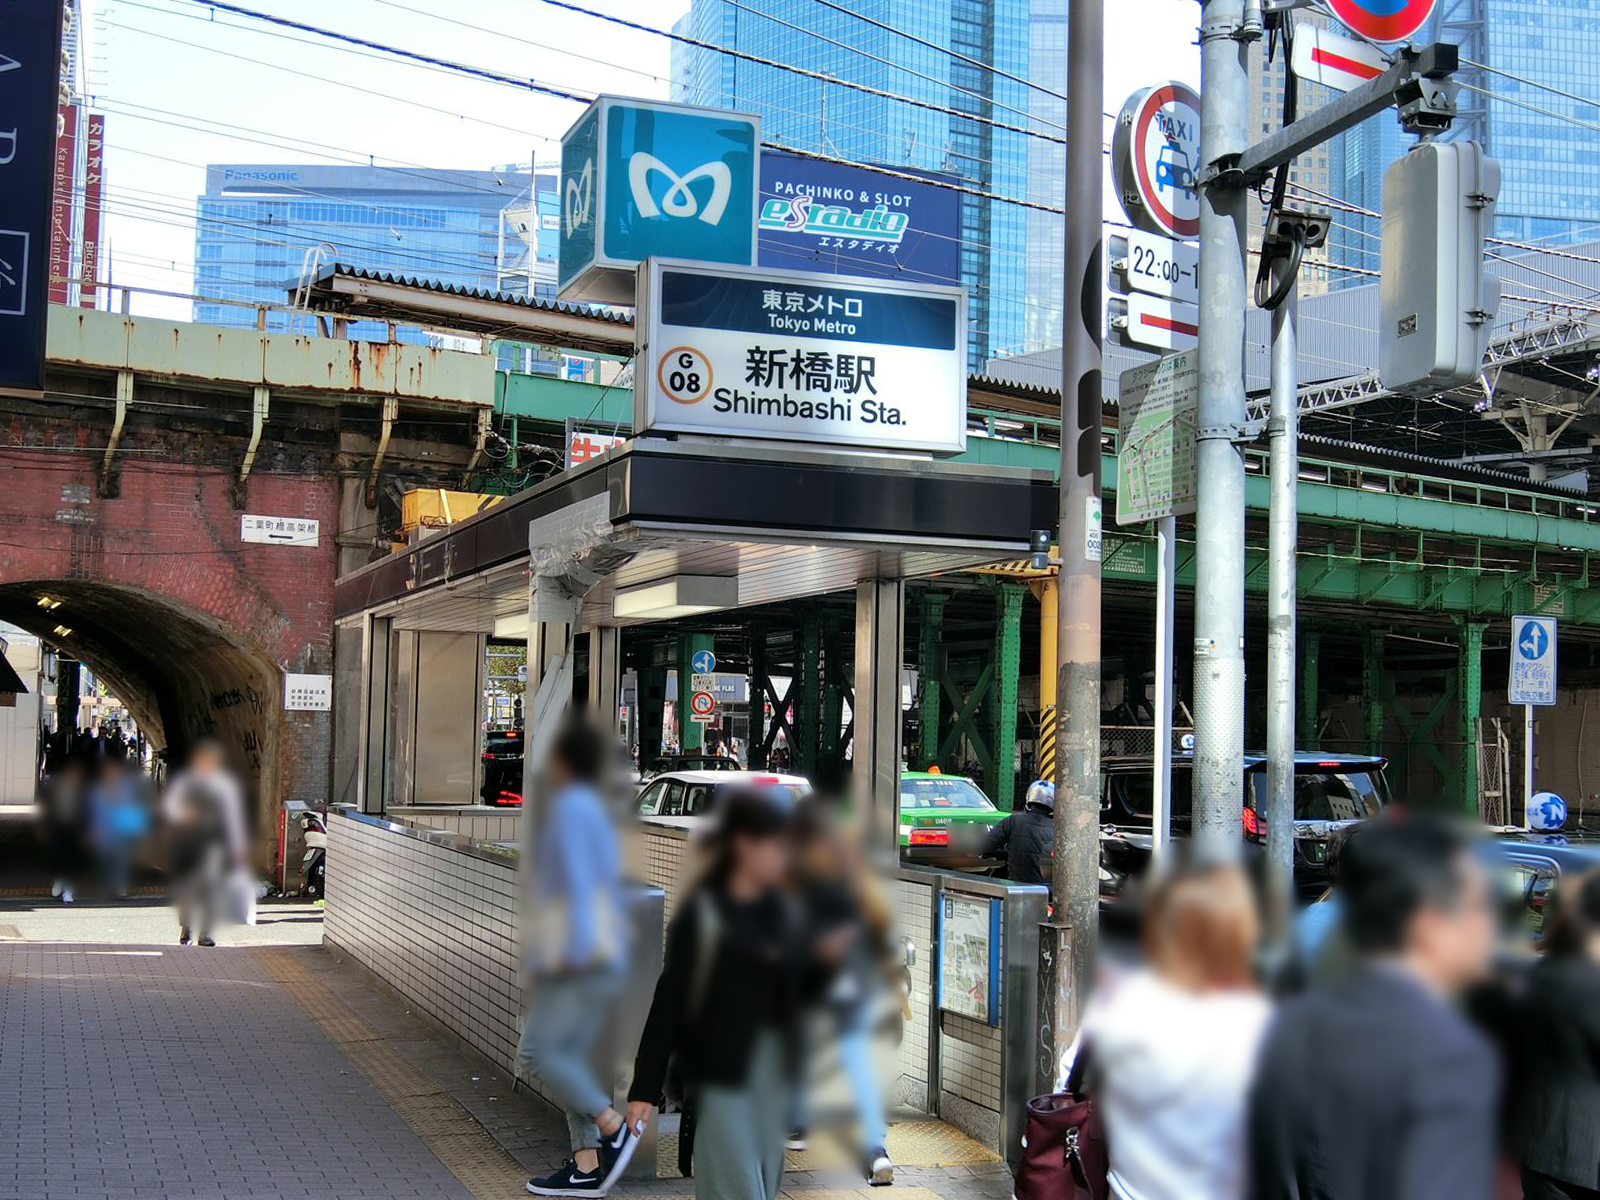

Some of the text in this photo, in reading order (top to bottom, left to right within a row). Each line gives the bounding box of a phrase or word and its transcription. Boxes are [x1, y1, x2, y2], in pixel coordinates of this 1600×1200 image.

[1157, 113, 1194, 142] TAXI
[87, 122, 104, 185] カラオケ
[225, 169, 299, 181] Panasonic
[775, 181, 912, 207] PACHINKO & SLOT
[818, 237, 900, 254] エスタディオ
[762, 289, 863, 318] 東京メトロ
[768, 314, 856, 336] Tokyo Metro
[678, 353, 694, 369] G
[745, 345, 877, 395] 新橋駅
[669, 372, 700, 394] 08
[713, 387, 907, 426] Shimbashi Sta.
